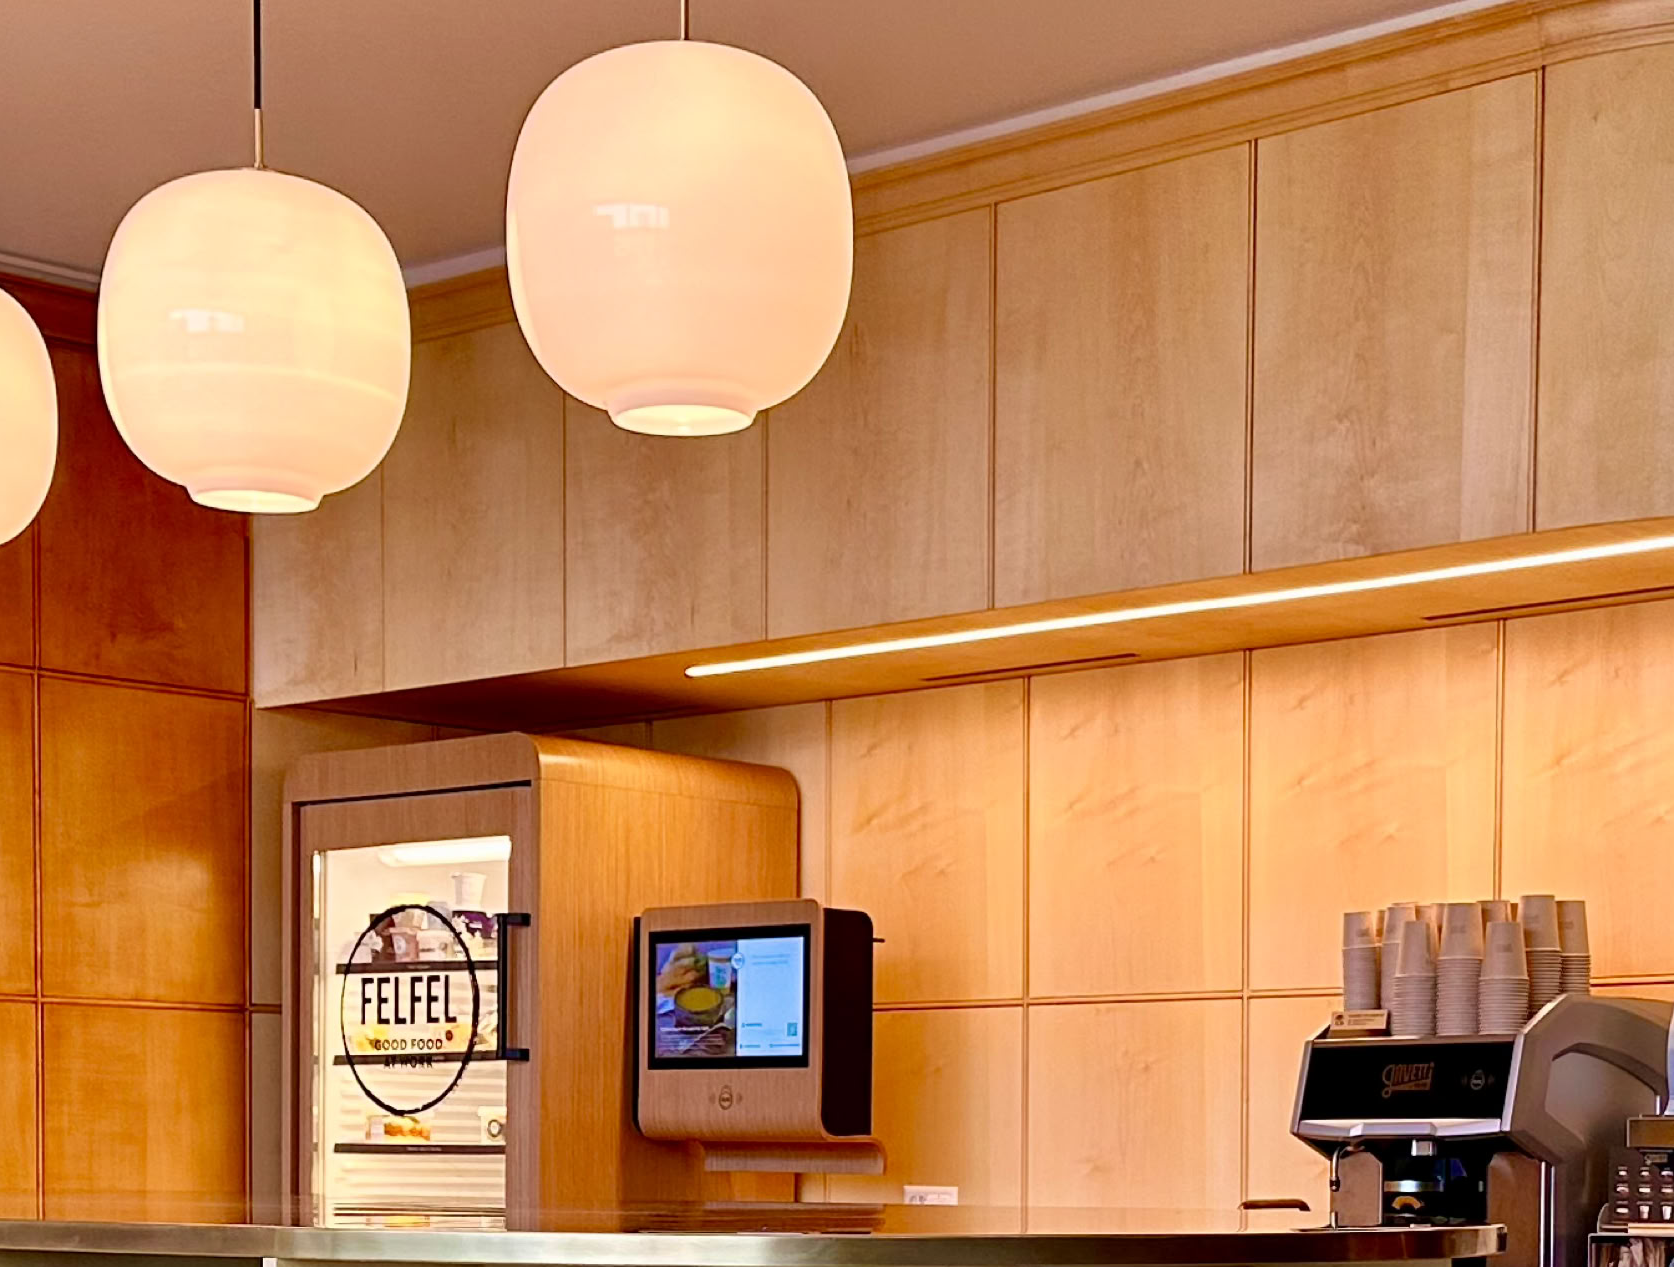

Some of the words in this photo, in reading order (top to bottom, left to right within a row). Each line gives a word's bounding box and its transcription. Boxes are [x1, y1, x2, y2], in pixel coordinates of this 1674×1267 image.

[360, 975, 457, 1024] FELFEL
[374, 1039, 407, 1050] GOOD
[411, 1038, 443, 1050] FOOD
